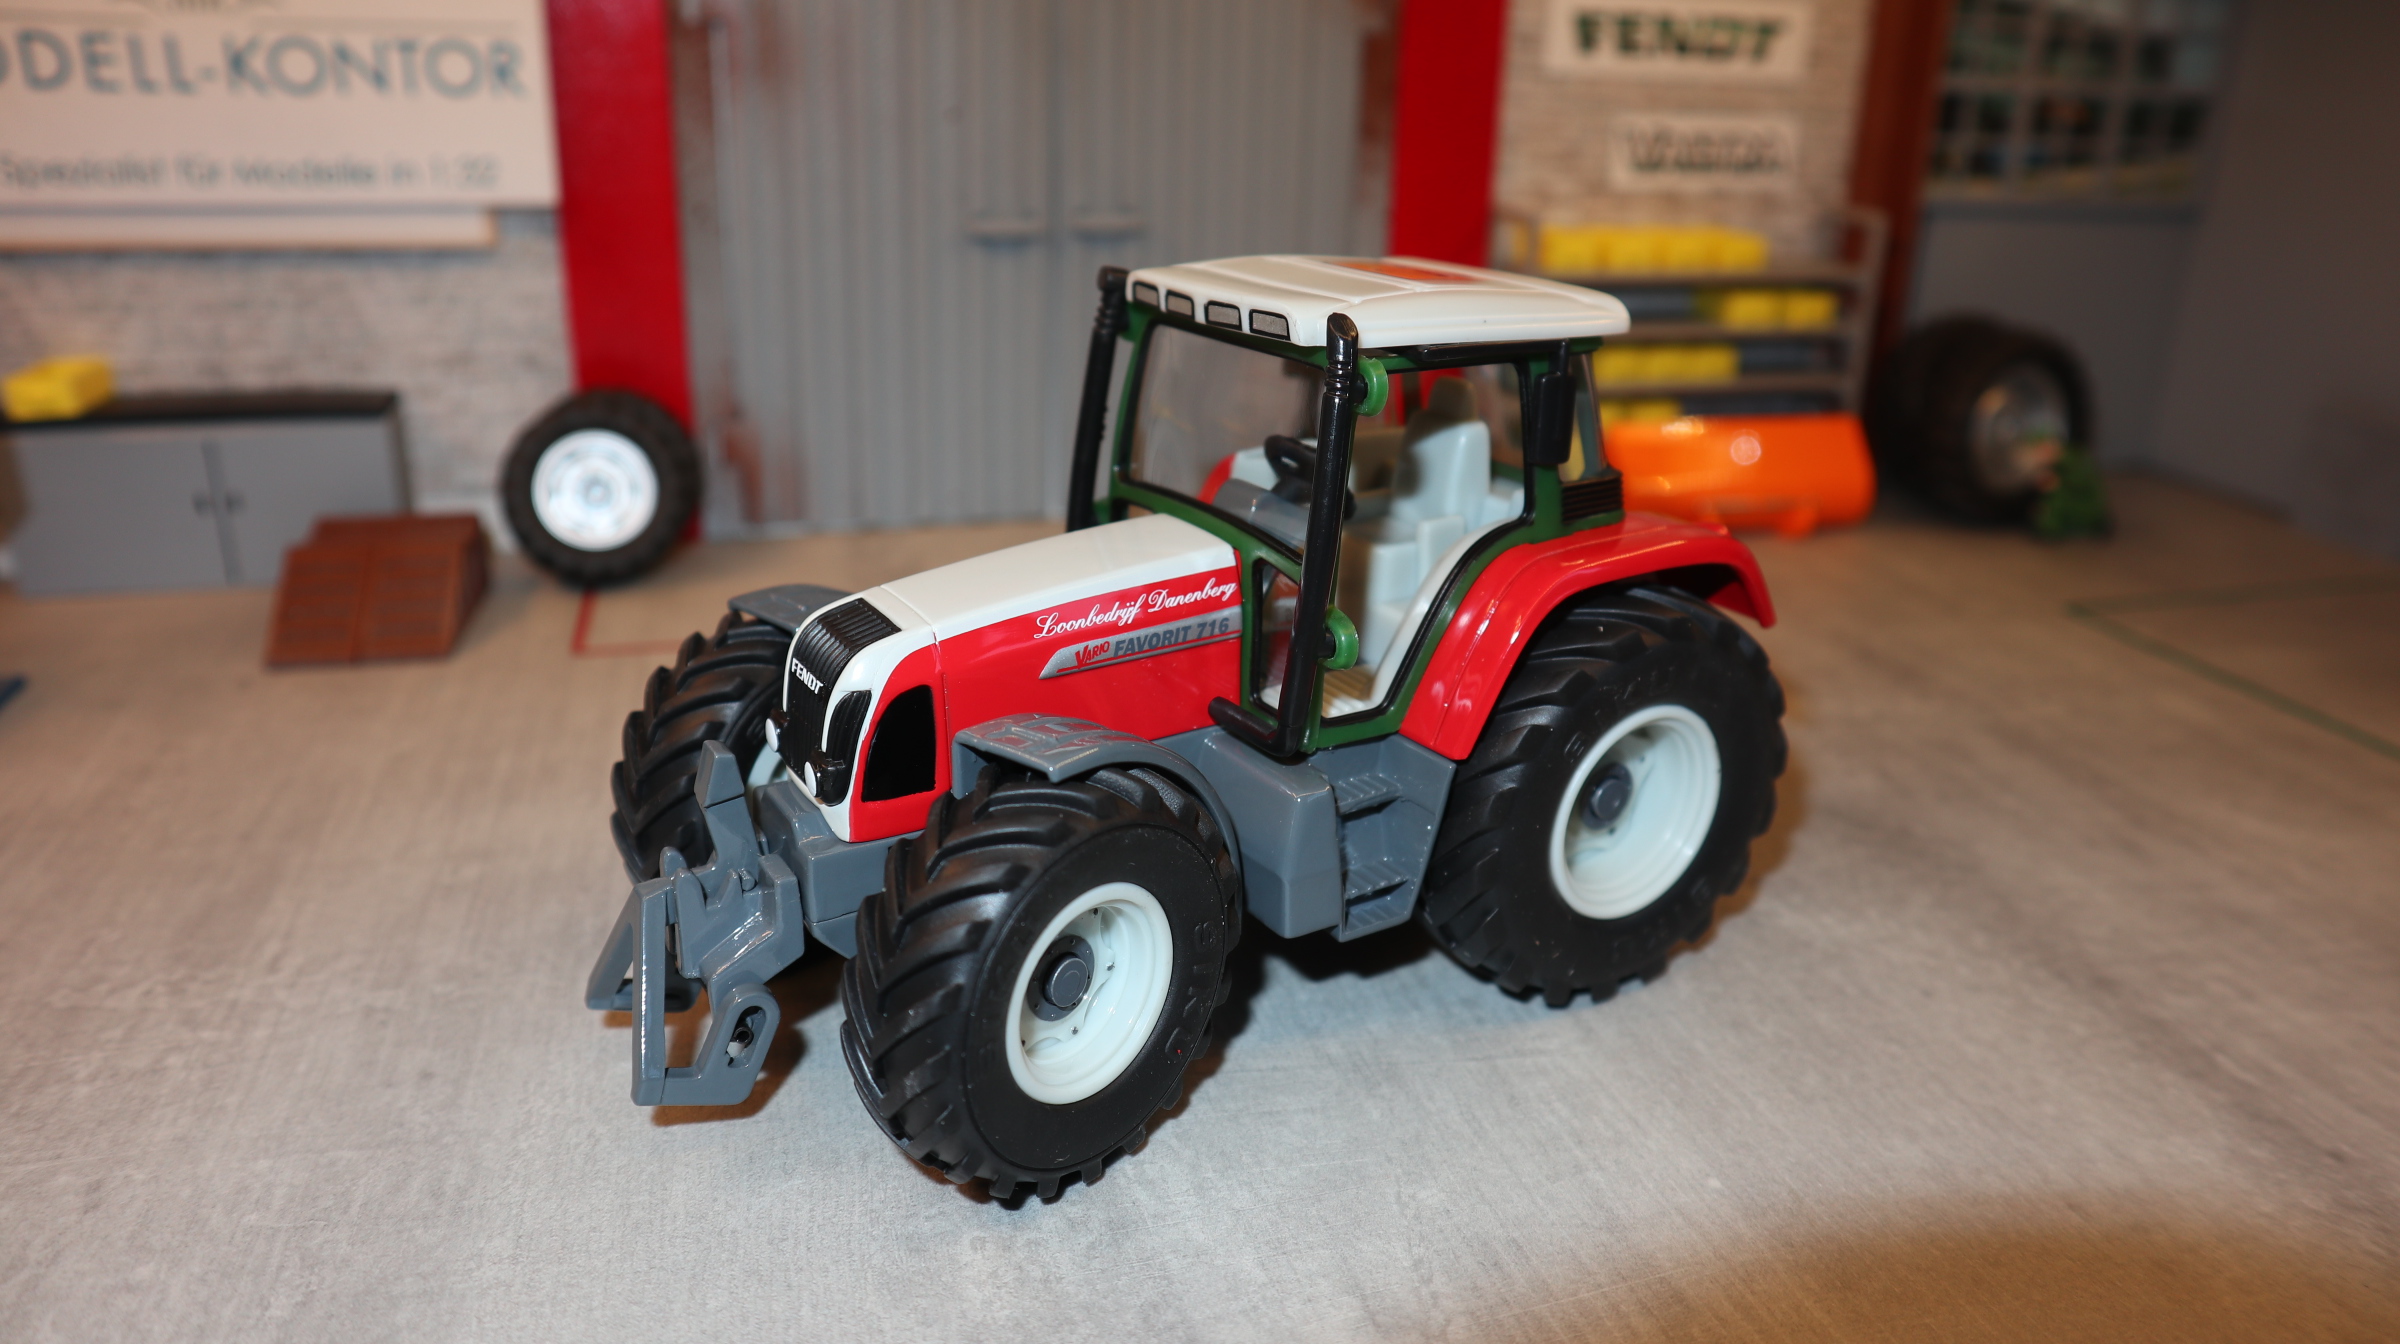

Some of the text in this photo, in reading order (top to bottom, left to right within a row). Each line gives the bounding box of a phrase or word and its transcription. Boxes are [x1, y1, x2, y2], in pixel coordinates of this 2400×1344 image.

[1572, 12, 1786, 61] FENDT
[0, 28, 526, 98] DELL-KONTOR
[1147, 577, 1238, 613] Danenberg
[1112, 626, 1193, 658] FAVORIT
[1196, 617, 1230, 639] 716
[790, 657, 824, 695] FENDT
